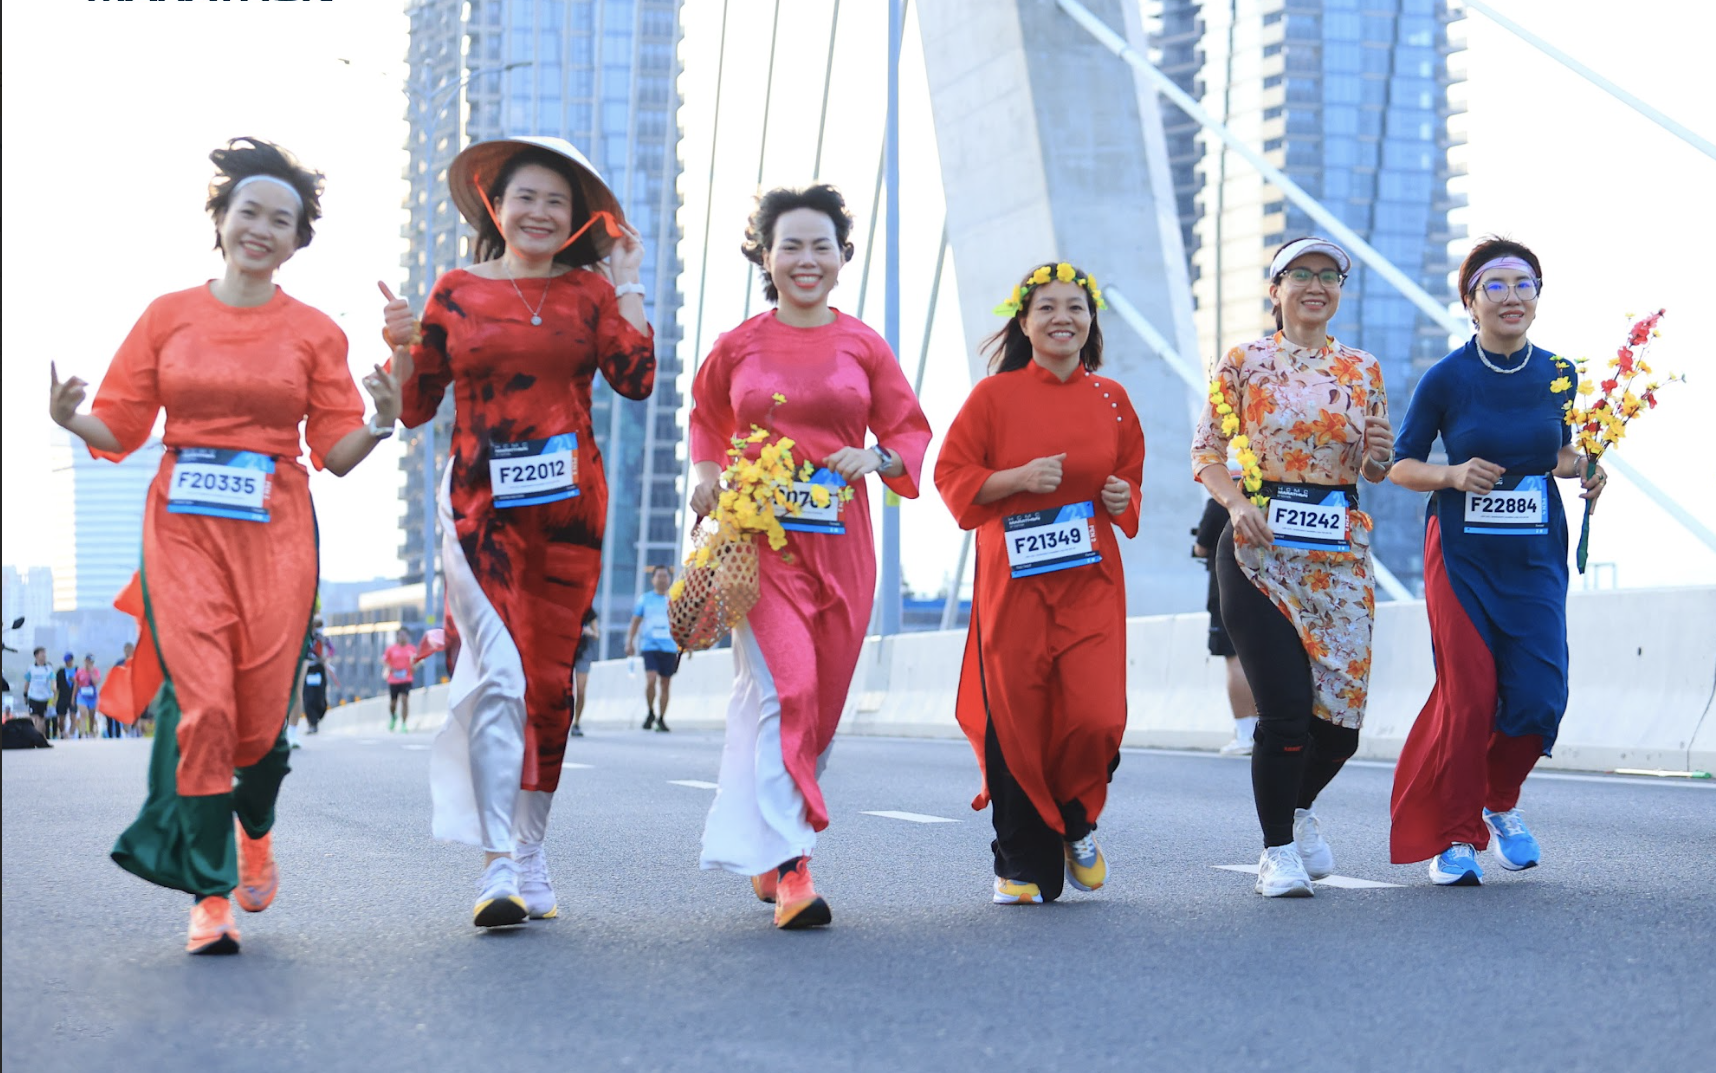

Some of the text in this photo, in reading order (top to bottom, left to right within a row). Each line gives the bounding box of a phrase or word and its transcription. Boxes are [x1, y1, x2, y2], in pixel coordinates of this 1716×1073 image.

[178, 472, 255, 494] F20335
[500, 460, 565, 484] F22012
[1471, 497, 1537, 513] F22884
[1275, 508, 1340, 529] F21242
[1014, 528, 1081, 554] F21349
